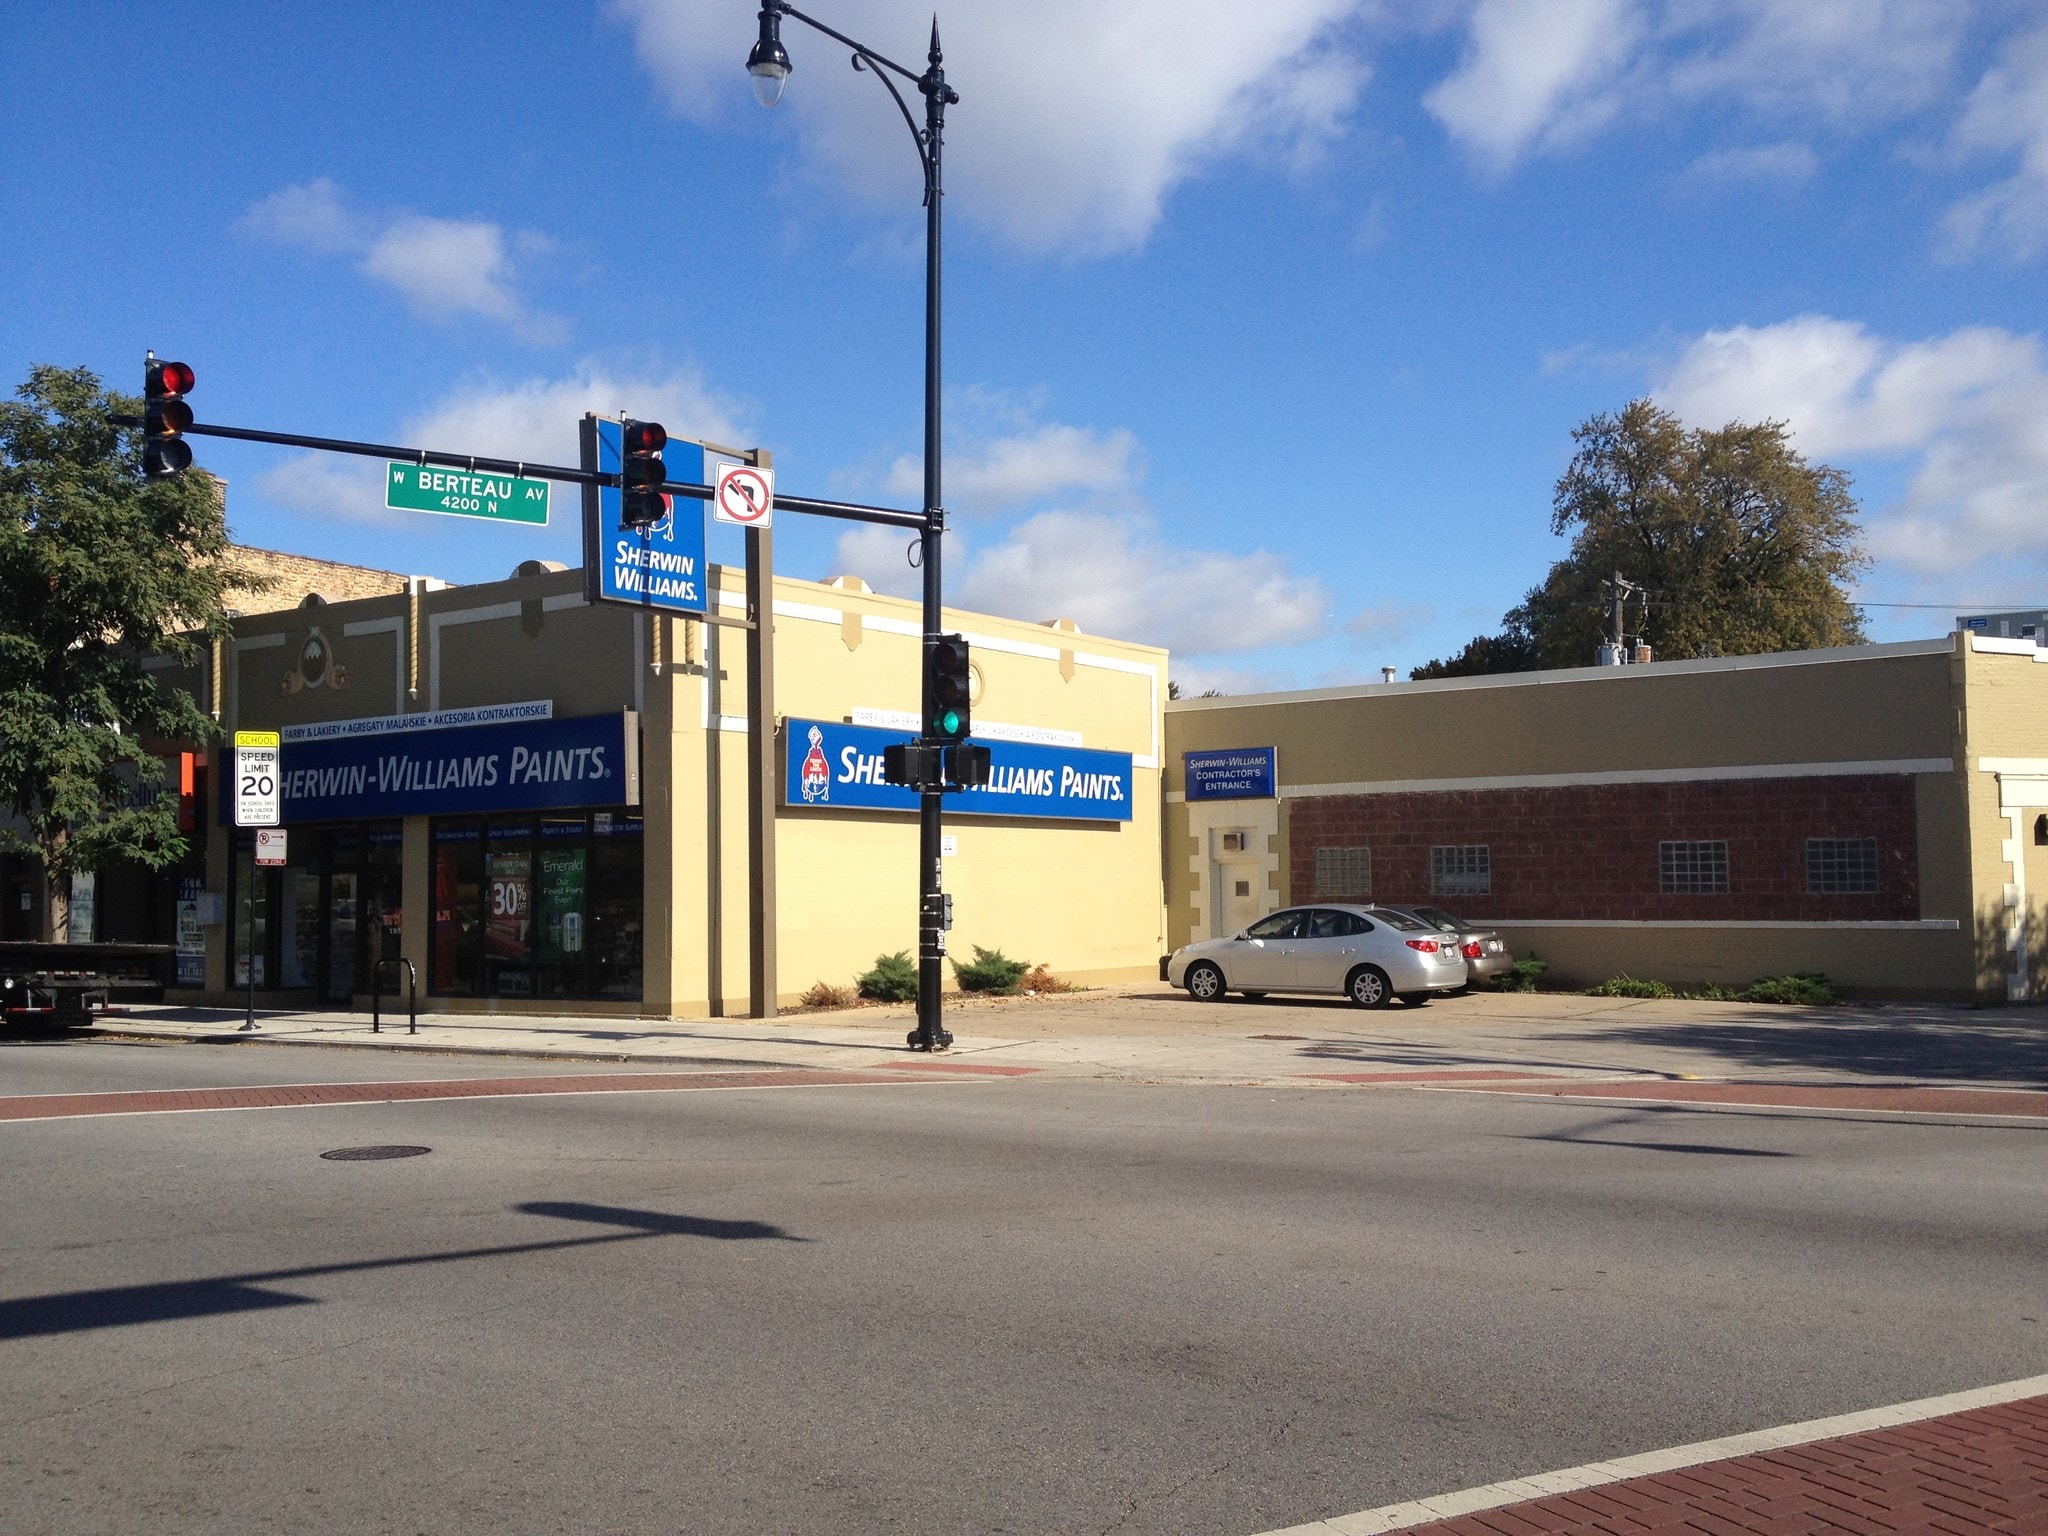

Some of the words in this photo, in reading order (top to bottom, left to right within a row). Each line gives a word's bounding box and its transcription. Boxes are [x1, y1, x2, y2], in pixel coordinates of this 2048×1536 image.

[393, 470, 405, 485] W
[418, 471, 512, 500] BERTEAU
[524, 487, 545, 502] AV
[440, 495, 480, 511] 4200
[487, 500, 498, 514] N
[614, 540, 695, 576] SHERWIN
[284, 728, 306, 740] FARBY
[306, 728, 312, 738] &
[313, 725, 341, 737] LAKIERY
[347, 721, 385, 733] AGREGATY
[434, 712, 475, 725] AKCESORIA
[477, 704, 548, 721] KONTRAKTORSKIE
[239, 735, 275, 745] SCHOOL
[240, 752, 275, 762] SPEED
[1189, 756, 1267, 769] SHERWIN-WILLIAMS
[244, 764, 270, 773] LIMIT
[280, 755, 499, 799] HERWIN-WILLIAMS
[1195, 769, 1261, 780] CONTRACTOR'S
[241, 776, 274, 796] 20
[1205, 780, 1252, 791] ENTRANCE
[543, 859, 583, 873] Emerald
[555, 877, 570, 886] Our
[543, 887, 564, 895] Finest
[565, 886, 584, 895] Paint
[554, 895, 572, 904] Ever!
[517, 902, 527, 911] OFF
